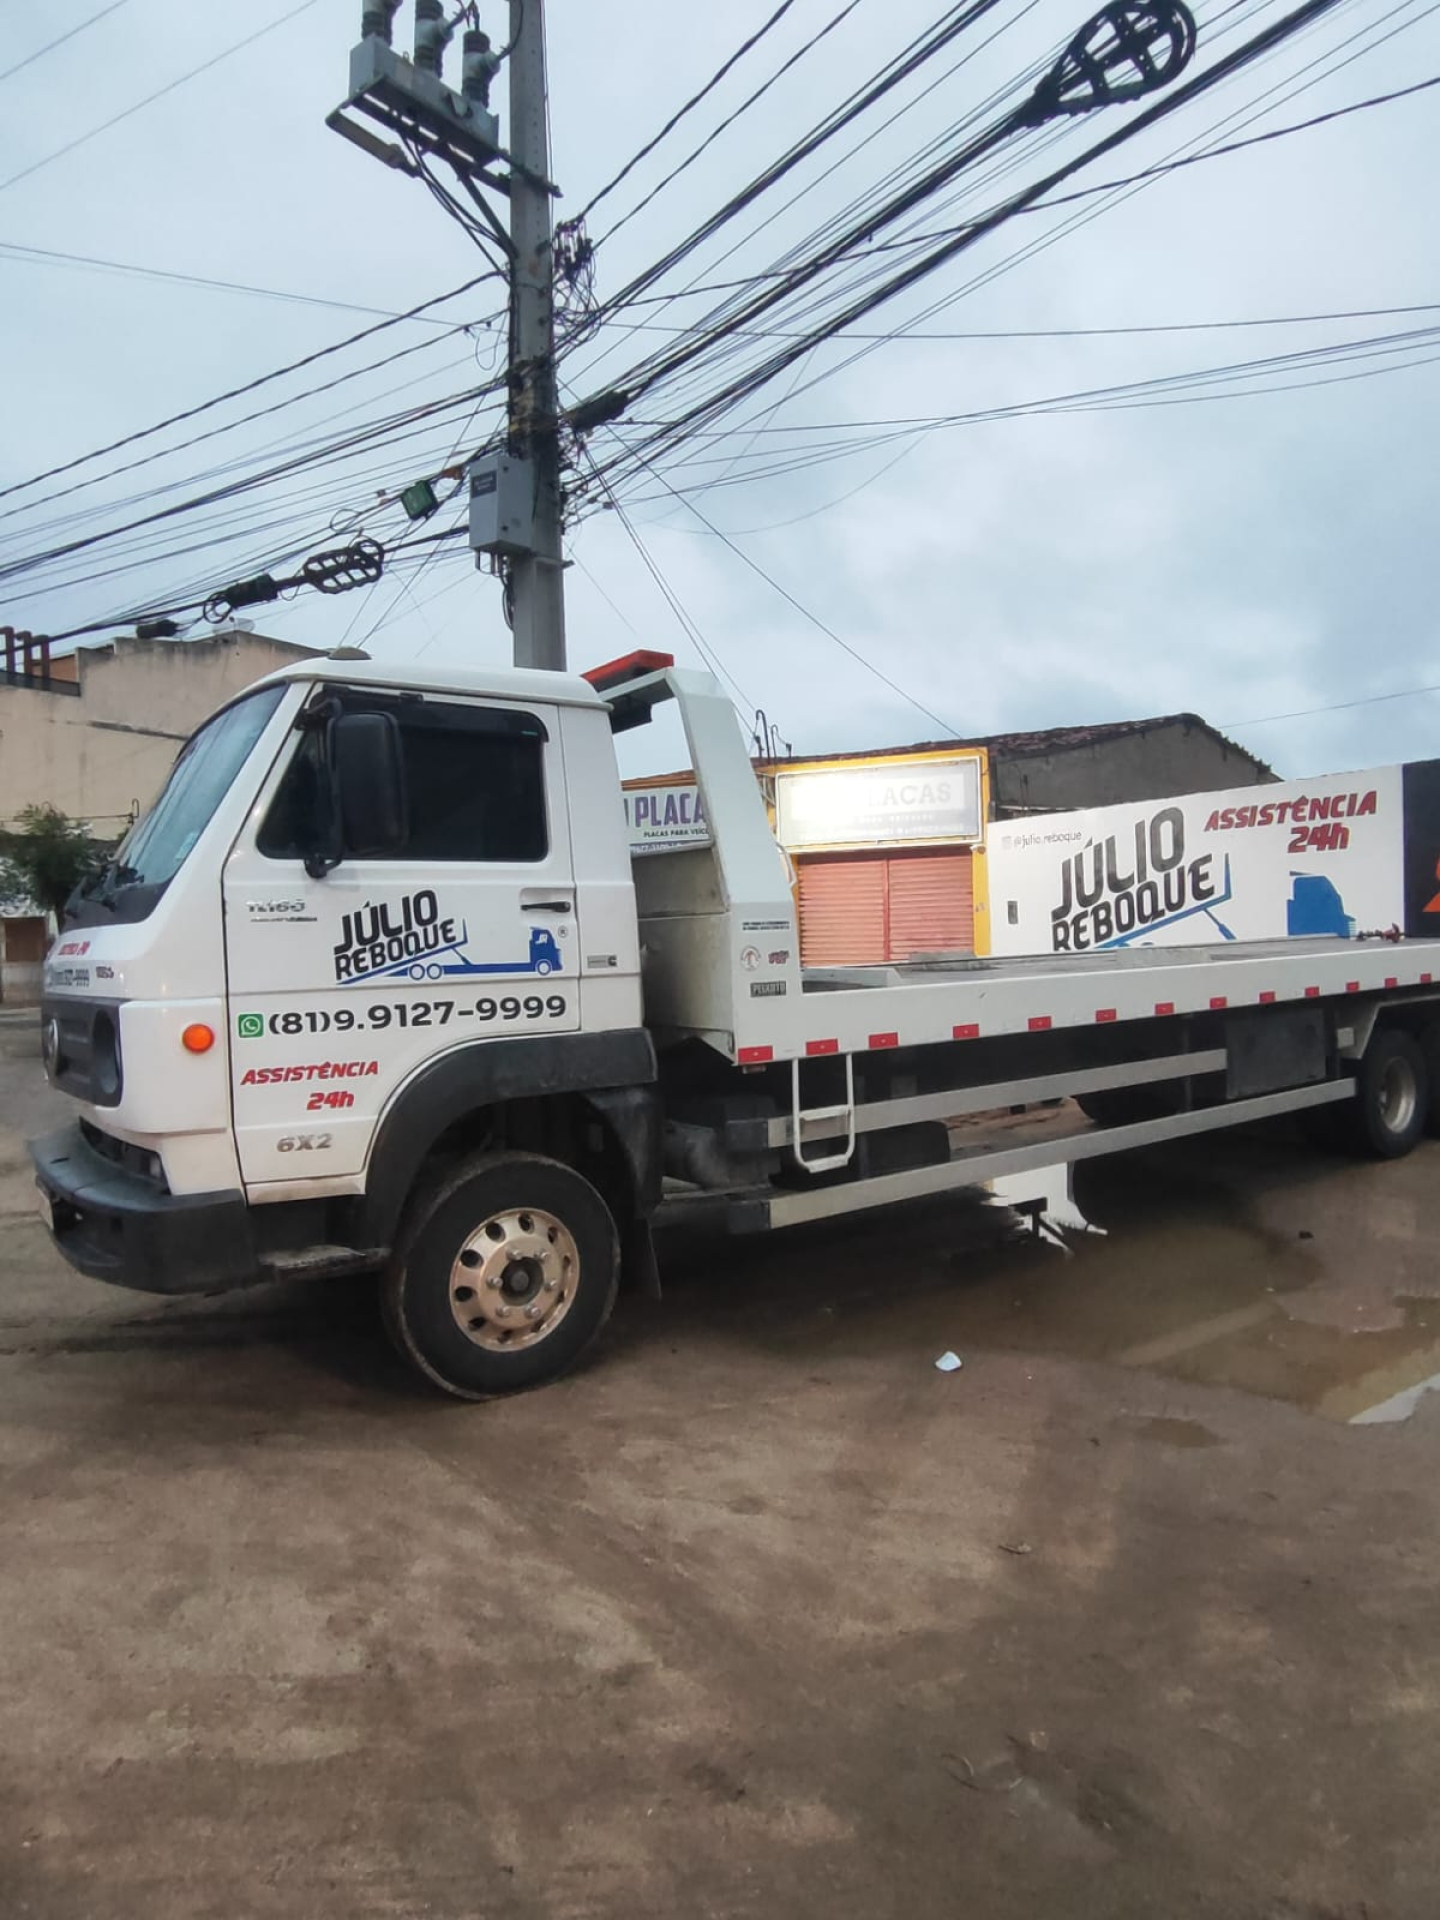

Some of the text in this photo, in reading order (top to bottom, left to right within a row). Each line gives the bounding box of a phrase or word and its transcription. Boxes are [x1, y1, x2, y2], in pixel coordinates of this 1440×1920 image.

[1204, 790, 1377, 832] ASSISTÊNCIA
[643, 829, 668, 838] PLACAS
[671, 828, 689, 837] PARA
[1288, 821, 1351, 853] 24h
[1051, 807, 1184, 924] JÚLIO
[334, 890, 439, 955] JÚLIO
[1052, 853, 1215, 952] REBOQUE
[334, 918, 456, 981] REBOQUE
[268, 995, 567, 1035] (81)9.9127-9999
[240, 1060, 379, 1086] ASSISTÊNCIA
[306, 1090, 355, 1111] 24h
[276, 1133, 333, 1153] 6X2
